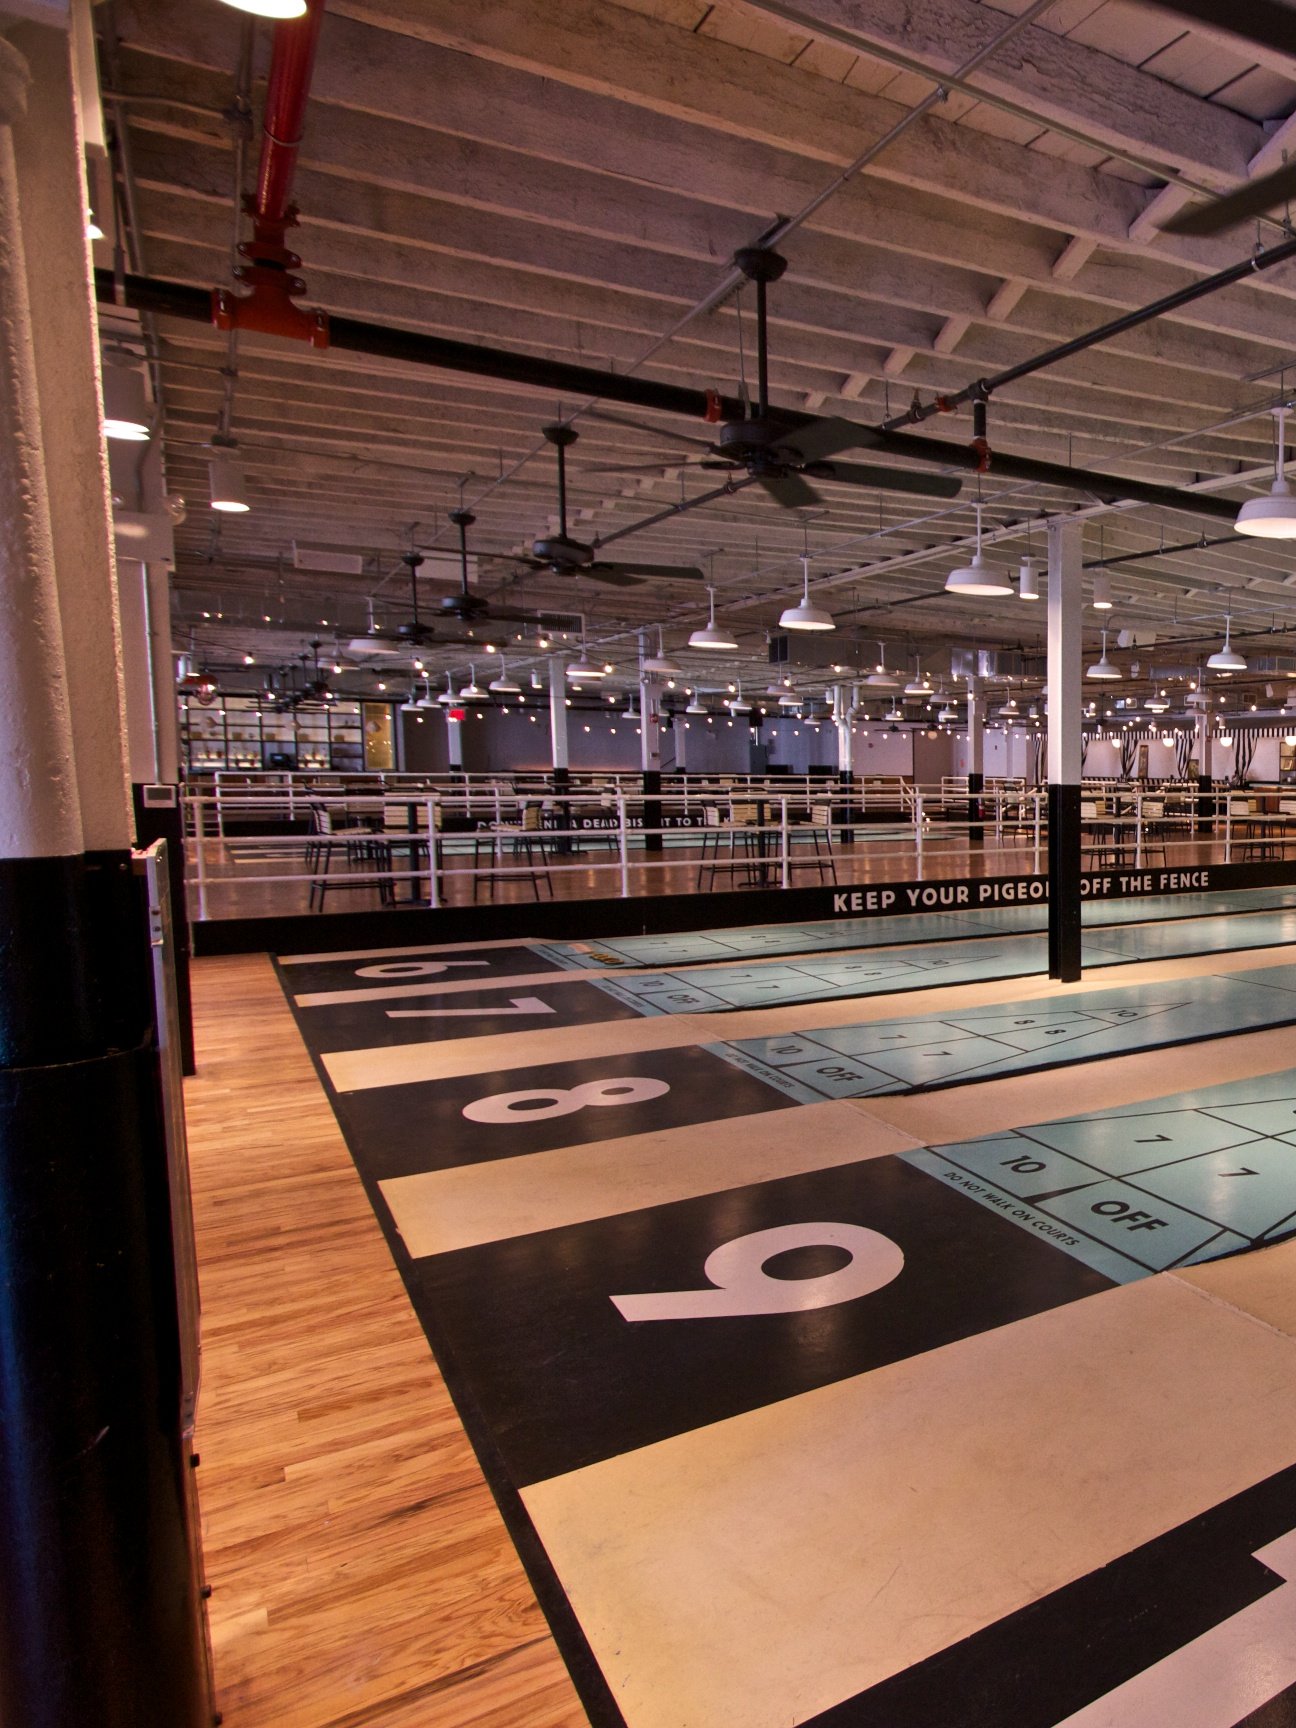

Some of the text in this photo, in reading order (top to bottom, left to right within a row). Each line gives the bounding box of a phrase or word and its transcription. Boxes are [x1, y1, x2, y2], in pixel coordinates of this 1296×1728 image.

[625, 816, 671, 828] BISIT
[833, 890, 896, 913] KEEP
[906, 885, 969, 908] YOUR
[1080, 877, 1112, 895] OFF
[1120, 874, 1152, 893] THE
[1160, 871, 1209, 890] FENCE
[1110, 1009, 1138, 1018] 10
[816, 1066, 864, 1081] OFF
[461, 1076, 670, 1124] 8
[1134, 1134, 1173, 1143] 7
[1000, 1154, 1046, 1174] 10
[1218, 1167, 1260, 1178] 7
[943, 1171, 1080, 1247] DO NOT WALK ON COURTS
[1090, 1200, 1170, 1232] OFF
[609, 1222, 904, 1322] 9
